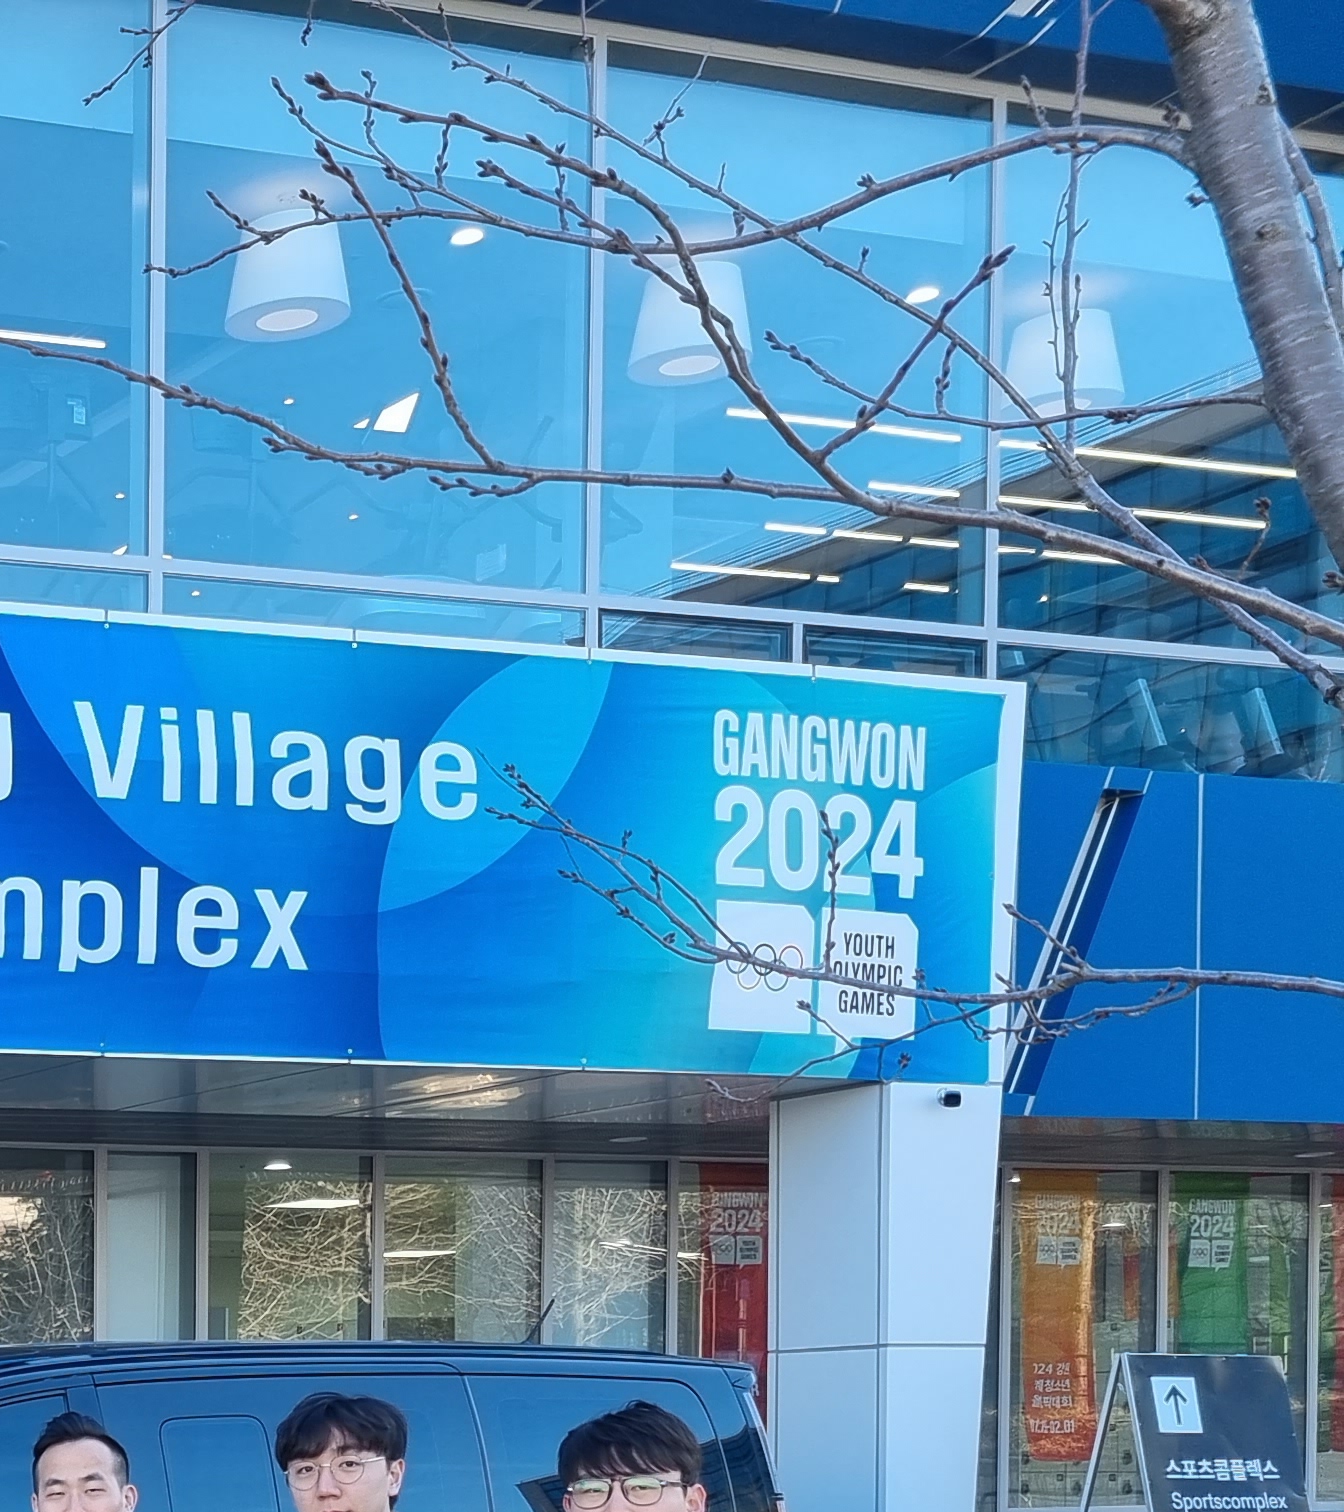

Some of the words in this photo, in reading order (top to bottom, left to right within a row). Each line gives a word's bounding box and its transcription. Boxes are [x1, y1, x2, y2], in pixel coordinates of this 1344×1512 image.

[73, 700, 478, 826] Village
[713, 708, 926, 791] GANGWON
[715, 785, 924, 899] 2024
[844, 931, 895, 960] YOUTH
[838, 989, 895, 1017] GAMES
[1189, 1214, 1236, 1238] 2024
[1165, 1458, 1281, 1482] 스포츠콤플렉스
